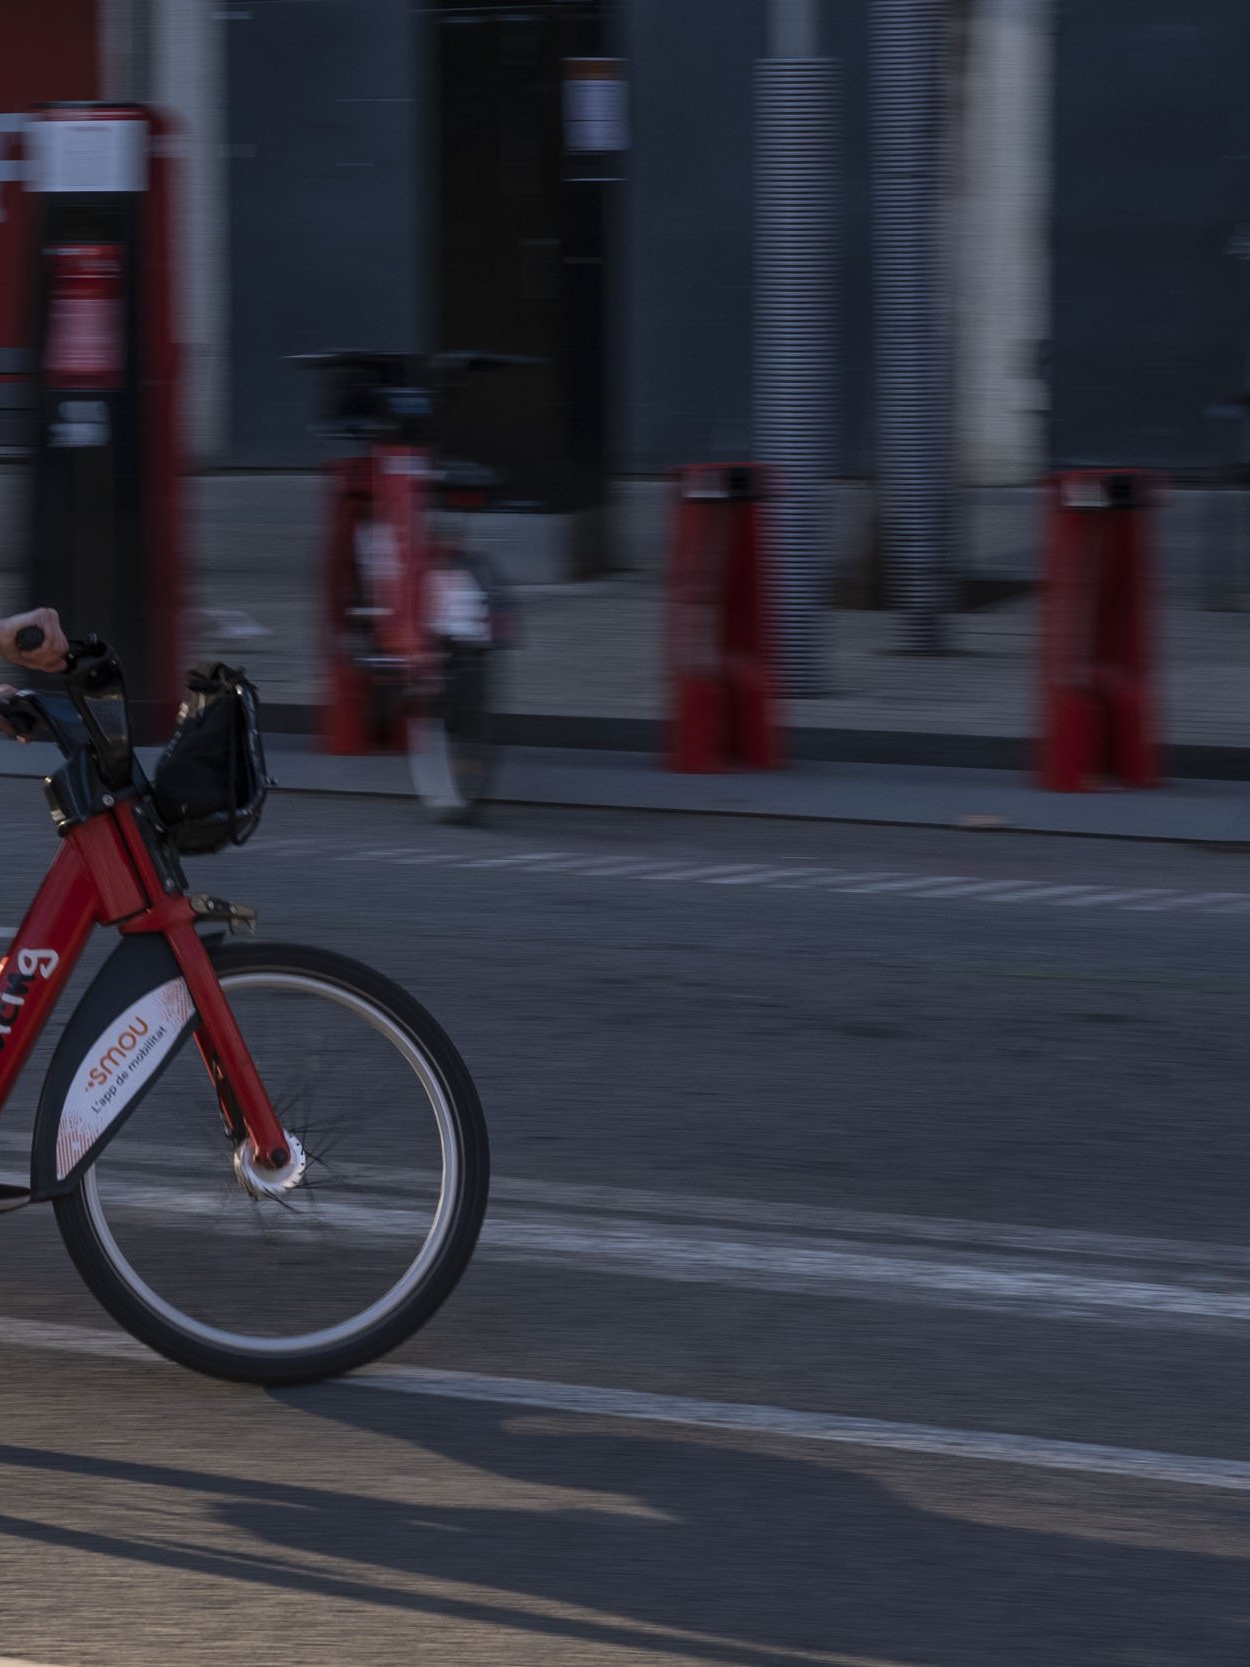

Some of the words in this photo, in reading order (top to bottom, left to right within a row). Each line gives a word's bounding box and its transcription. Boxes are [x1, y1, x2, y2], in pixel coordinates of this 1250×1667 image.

[88, 1016, 149, 1086] smou
[91, 1086, 117, 1114] L'app
[116, 1071, 129, 1086] de
[128, 1026, 167, 1072] mobilitat
